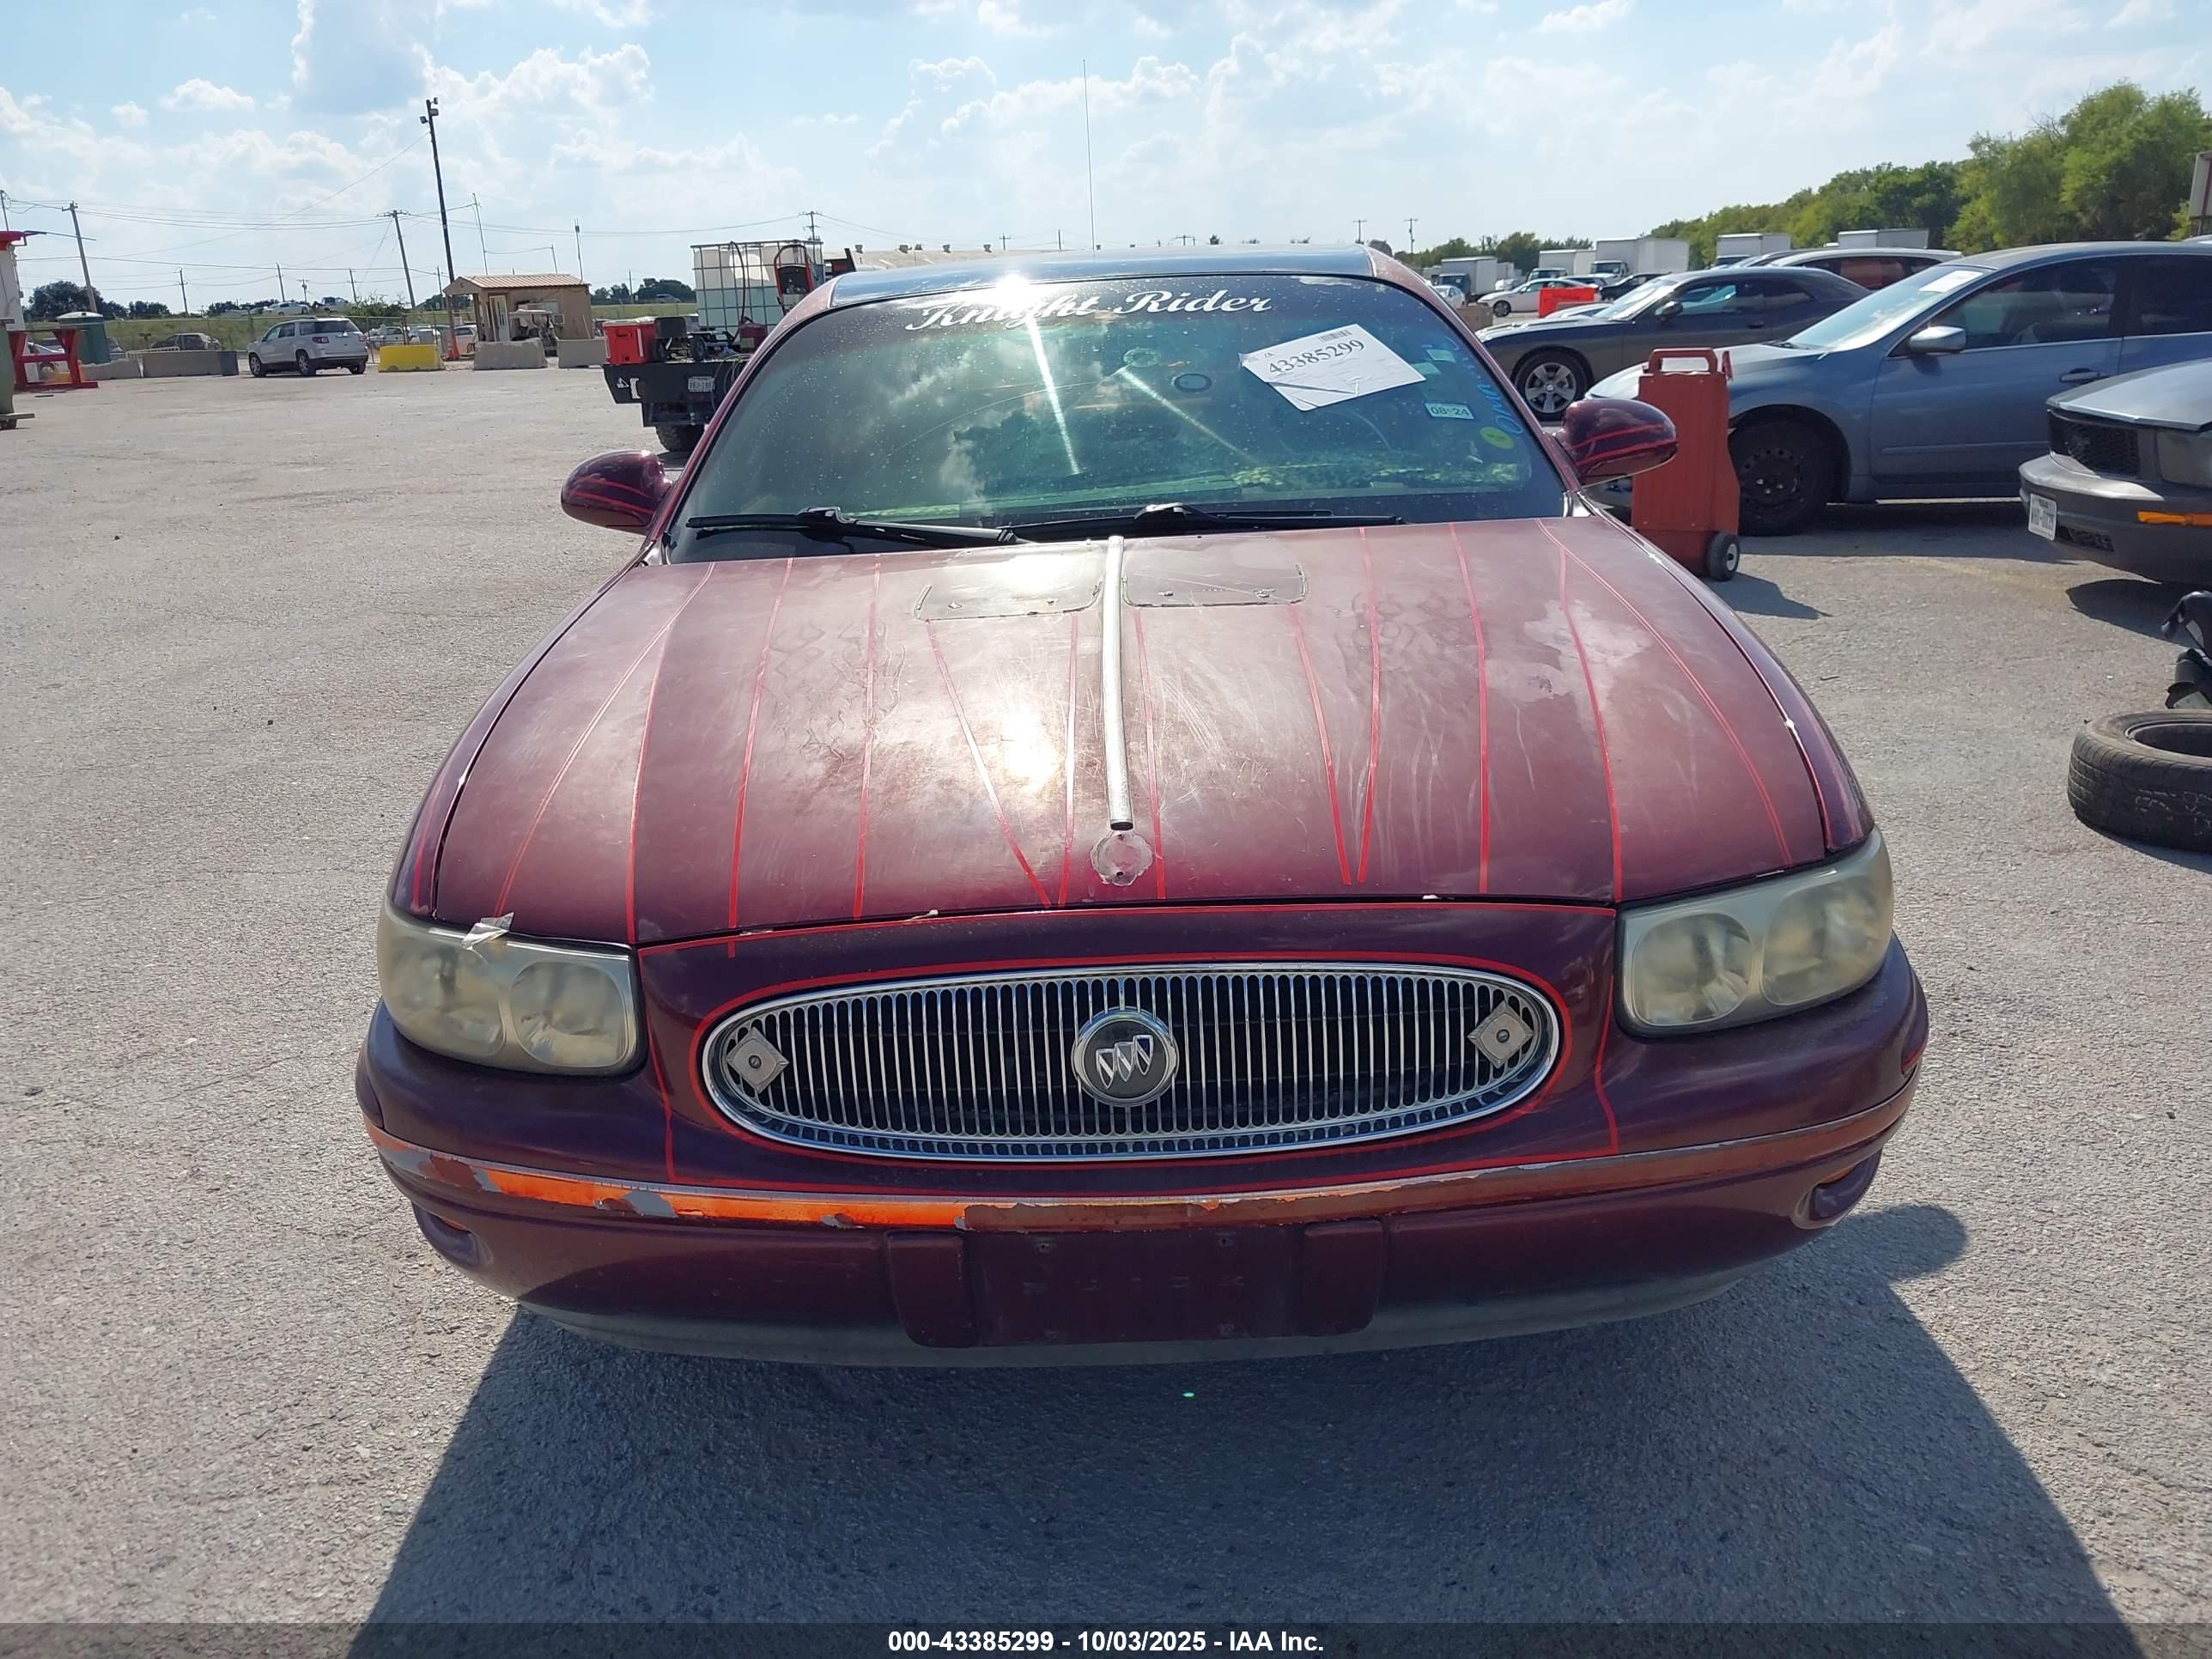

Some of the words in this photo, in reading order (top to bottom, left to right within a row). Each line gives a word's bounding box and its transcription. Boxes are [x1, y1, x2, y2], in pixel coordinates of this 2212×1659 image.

[905, 293, 1100, 331] Knight
[1112, 289, 1272, 314] Rider
[1268, 338, 1366, 375] 43385299
